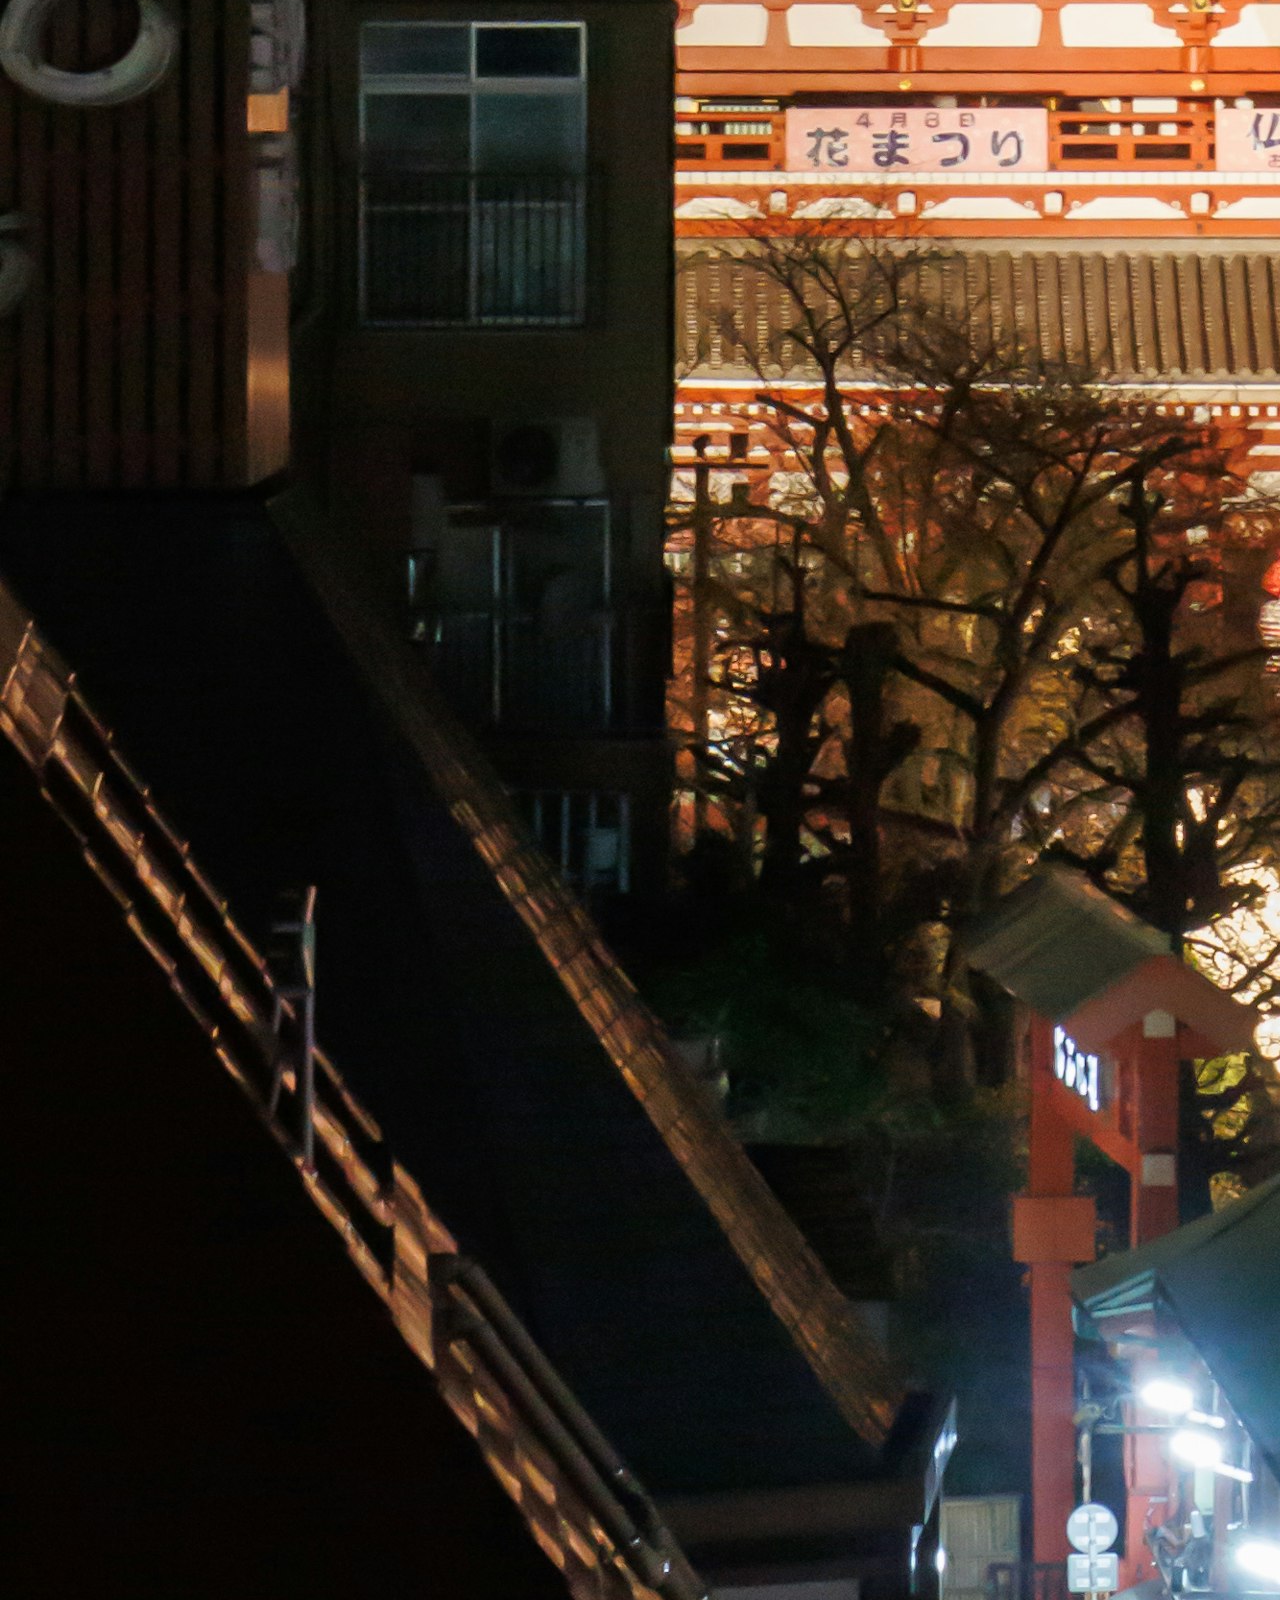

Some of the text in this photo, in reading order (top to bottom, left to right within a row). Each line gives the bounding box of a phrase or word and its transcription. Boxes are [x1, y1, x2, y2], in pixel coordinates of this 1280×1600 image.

[855, 111, 976, 129] 4月8日
[805, 127, 1024, 168] 花まつり
